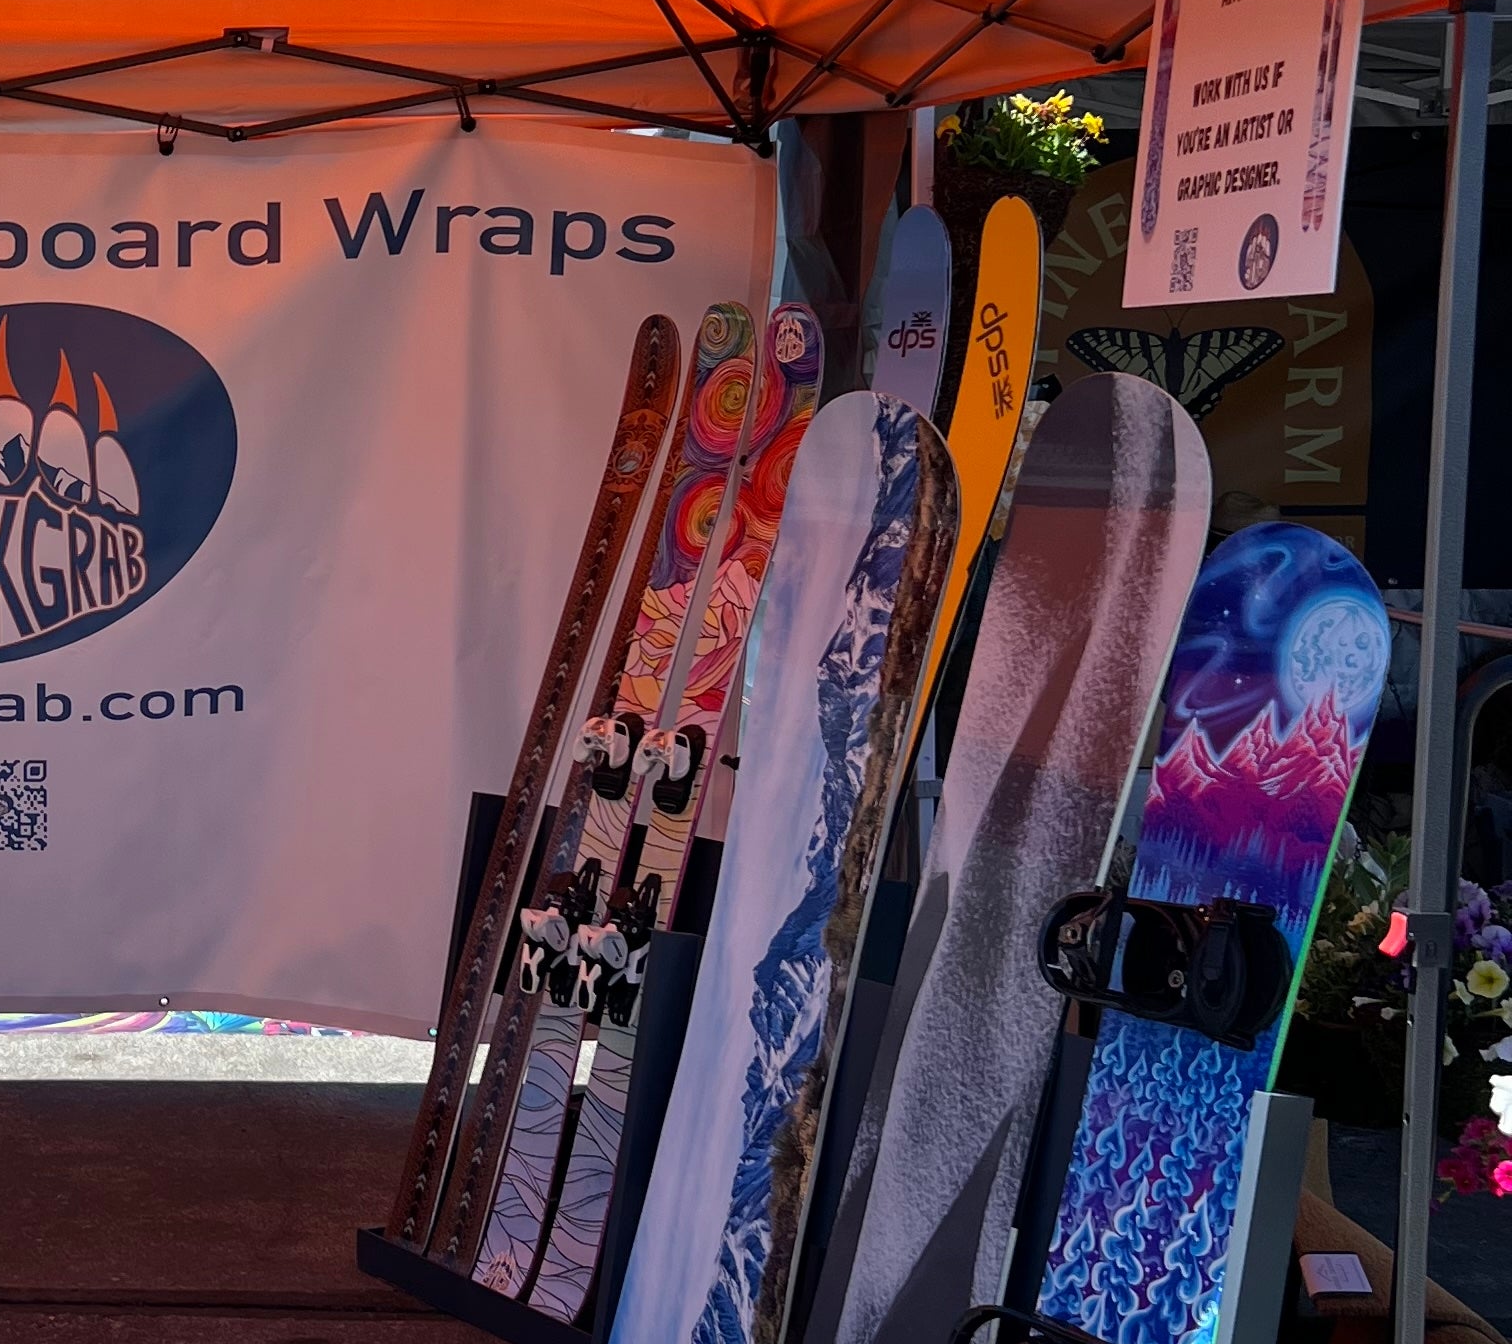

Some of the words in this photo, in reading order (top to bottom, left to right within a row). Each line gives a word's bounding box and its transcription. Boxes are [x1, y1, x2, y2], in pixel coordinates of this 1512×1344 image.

[1192, 77, 1221, 108] WORK
[1223, 69, 1251, 100] WITH
[1254, 64, 1270, 92] US
[1271, 60, 1285, 89] IF
[1176, 126, 1212, 157] YOU'RE
[1213, 122, 1231, 149] AN
[1232, 111, 1274, 145] ARTIST
[1276, 108, 1295, 136] OR
[1177, 170, 1222, 202] GRAPHIC
[1223, 160, 1281, 195] DESIGNER.
[324, 187, 676, 277] Wraps
[888, 320, 936, 358] dps
[975, 302, 1009, 377] dps
[1284, 302, 1348, 484] ARM
